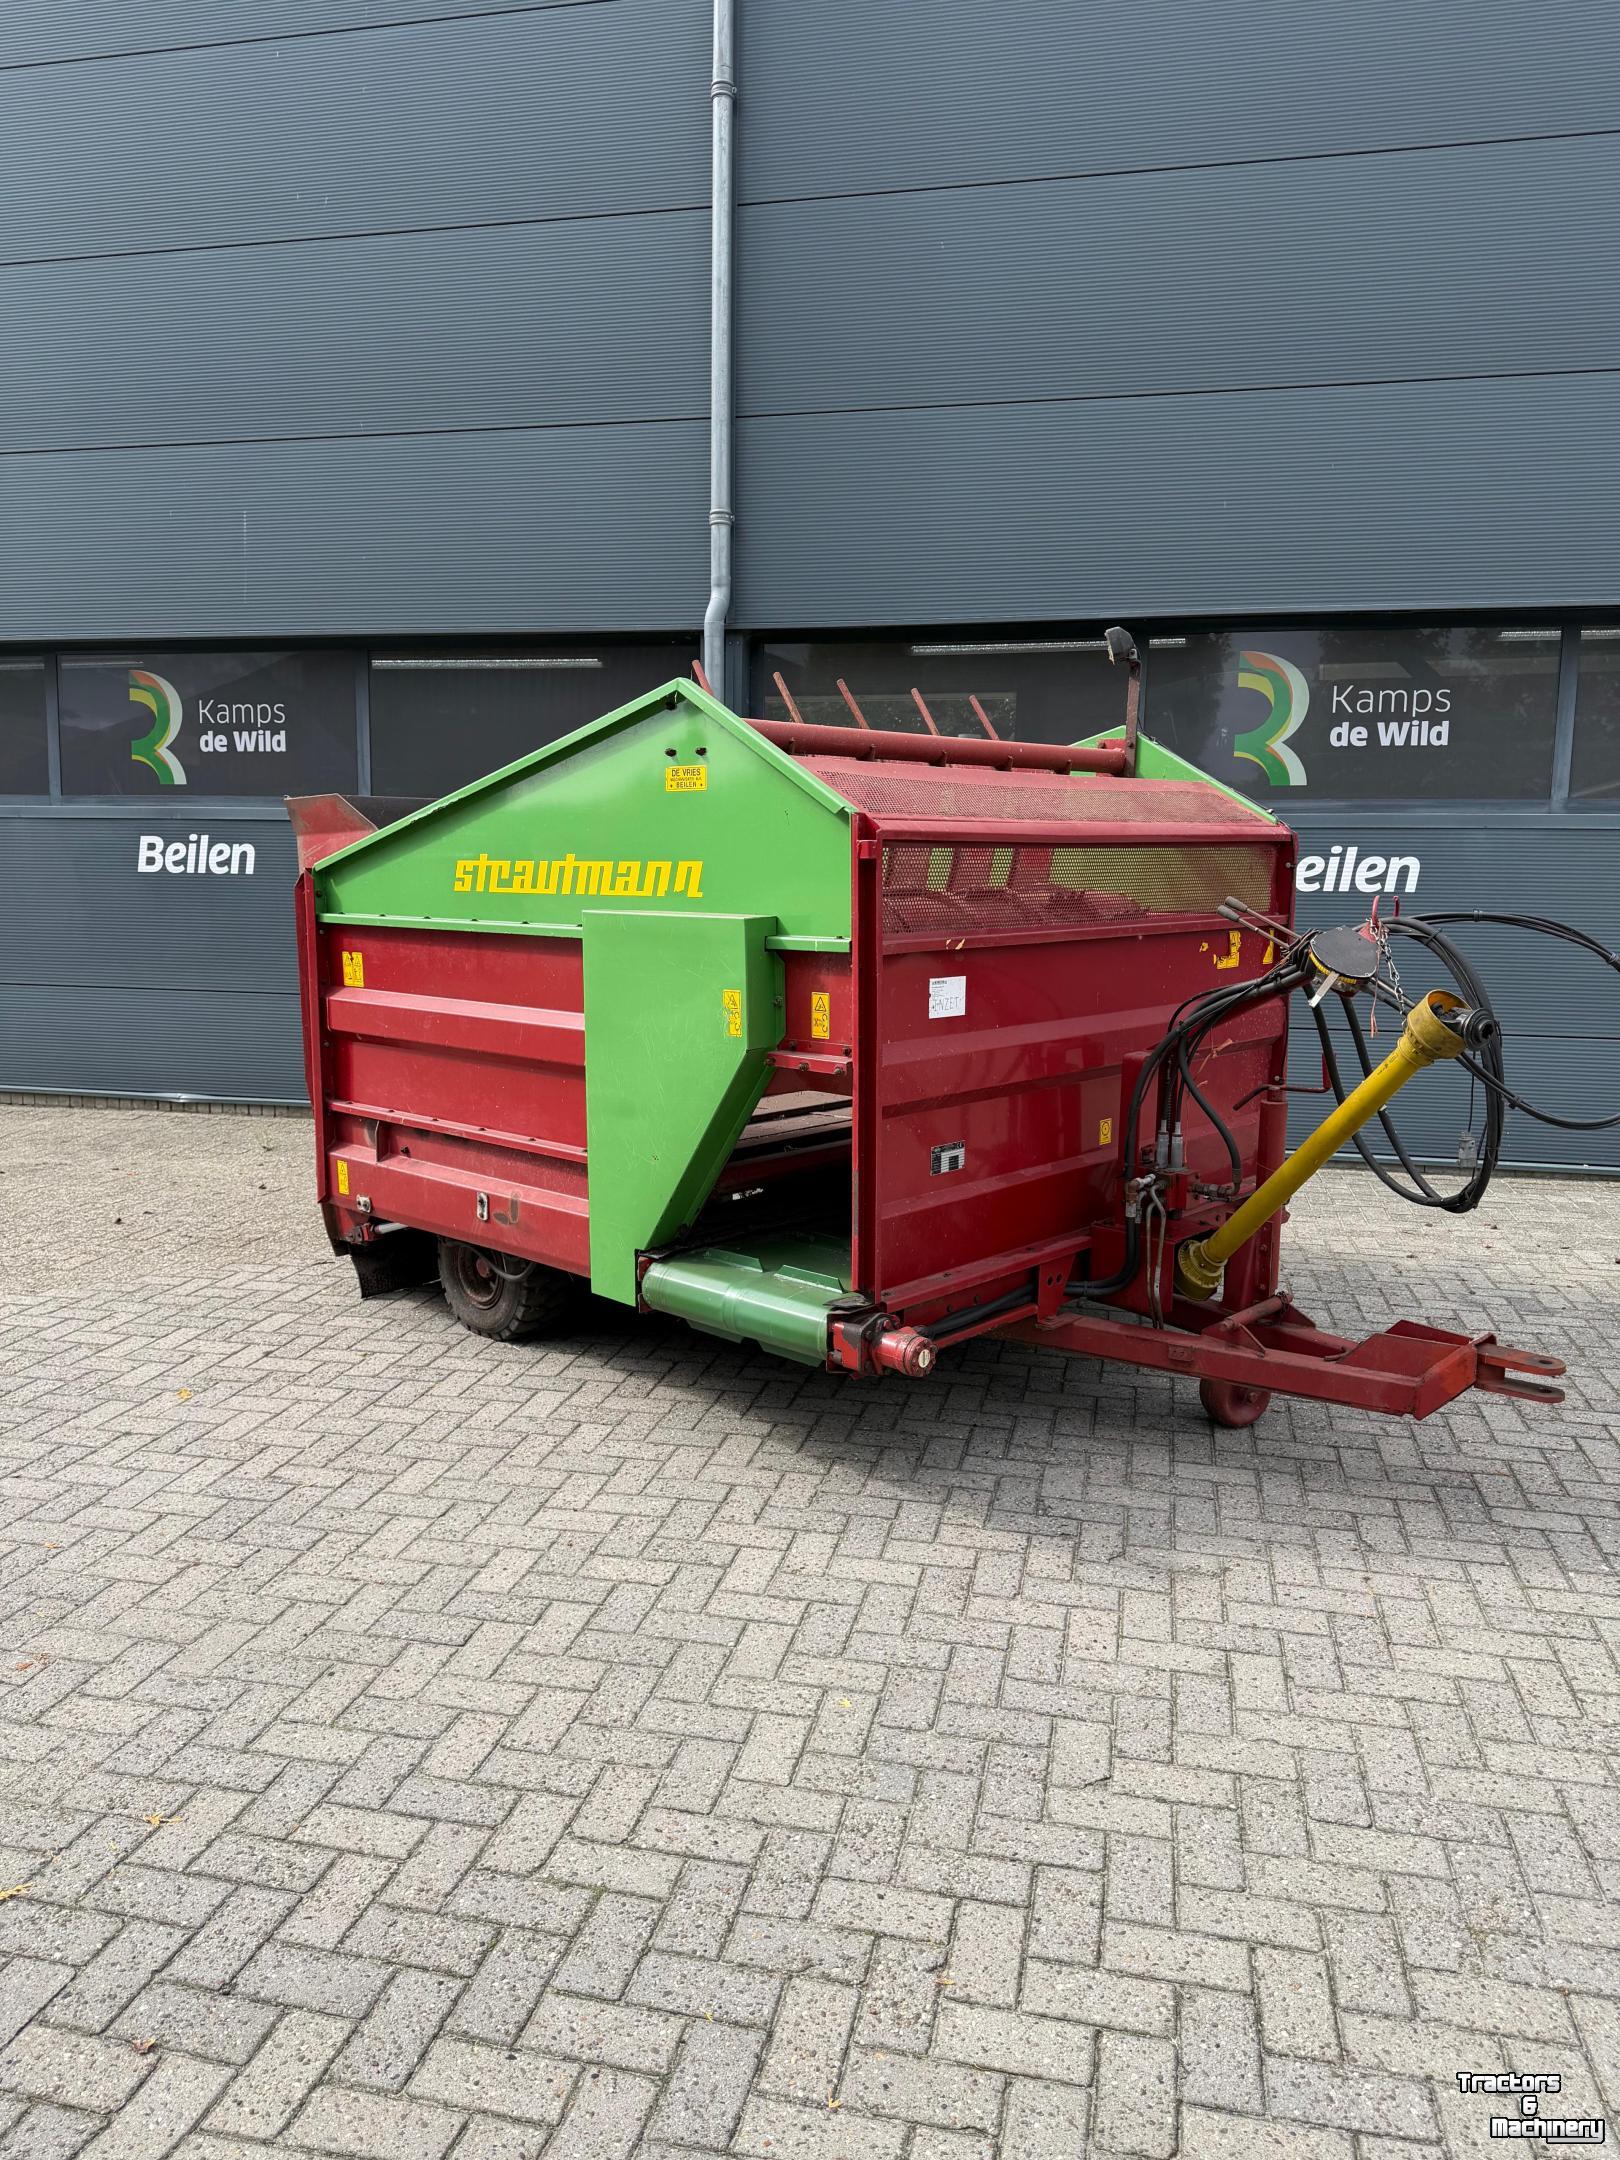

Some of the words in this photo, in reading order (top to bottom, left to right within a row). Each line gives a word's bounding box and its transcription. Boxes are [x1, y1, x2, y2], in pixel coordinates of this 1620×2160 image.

[198, 699, 286, 728] Kamps
[1331, 684, 1452, 718] Kamps
[199, 730, 228, 752] de
[232, 729, 287, 752] Wild
[1329, 721, 1369, 747] de
[1376, 719, 1450, 747] Wild
[671, 769, 681, 777] DE
[682, 768, 701, 777] VRIES
[137, 833, 256, 875] Beilen
[1295, 845, 1421, 893] eilen
[453, 853, 704, 898] strautmann
